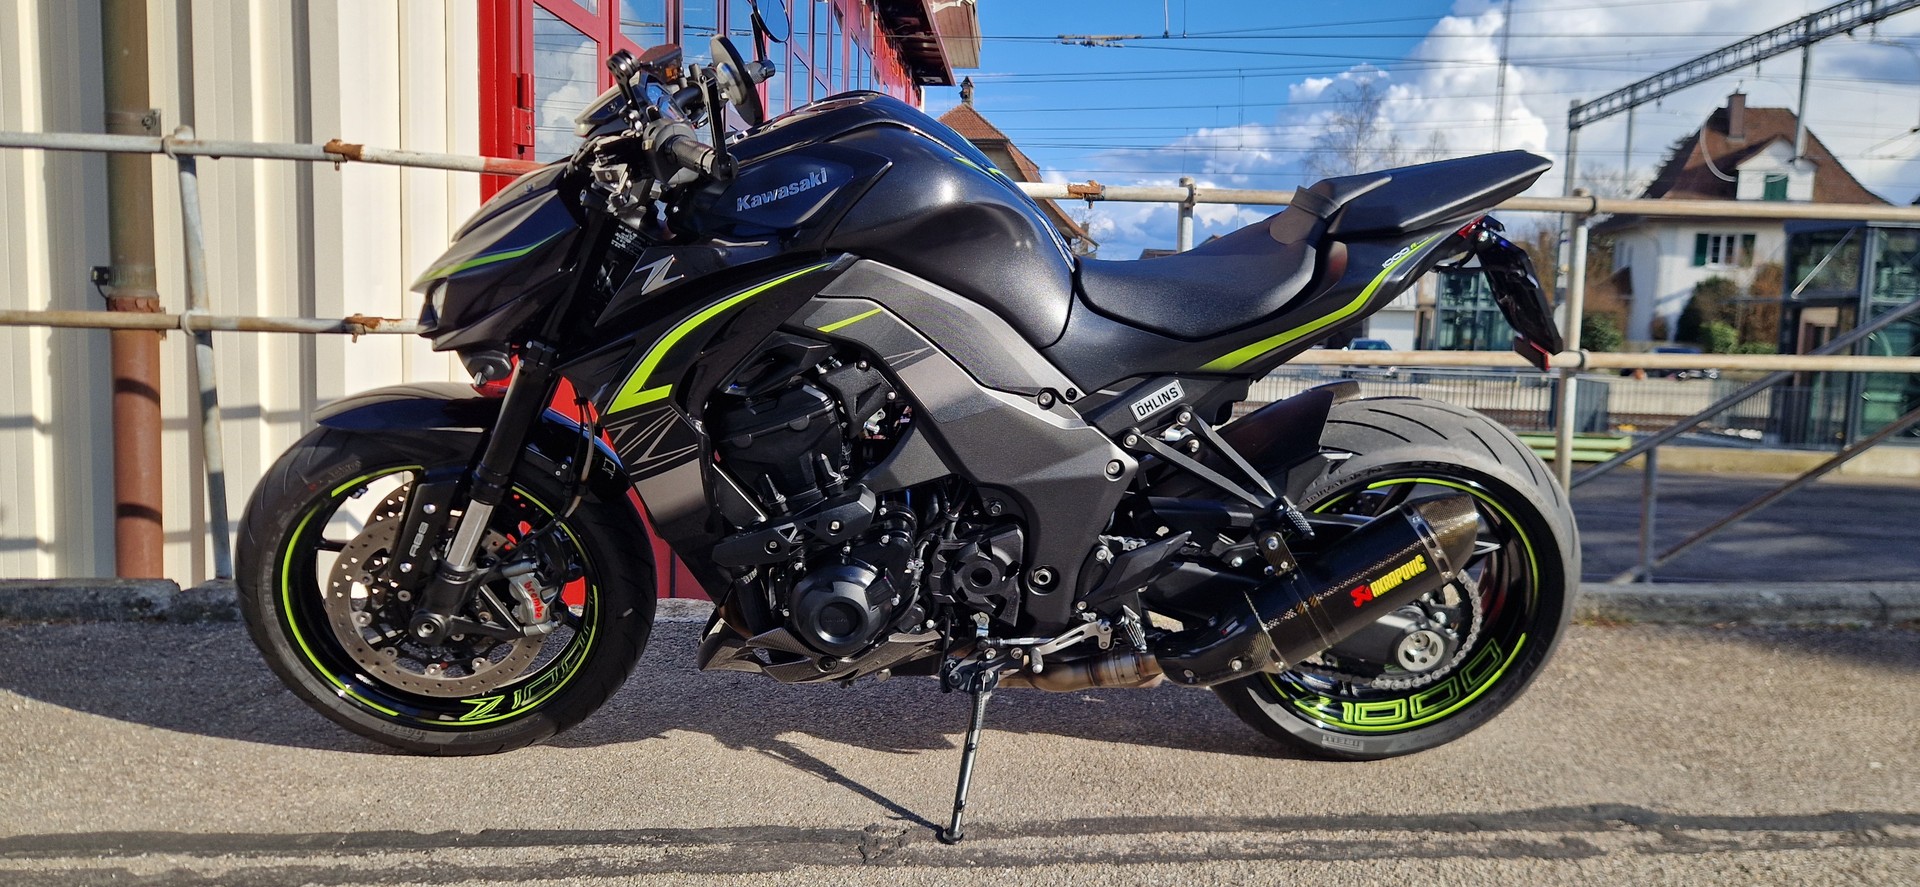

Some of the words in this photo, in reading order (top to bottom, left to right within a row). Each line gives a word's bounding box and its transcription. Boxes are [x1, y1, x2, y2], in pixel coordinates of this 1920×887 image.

[736, 167, 828, 212] Kawasaki
[1381, 246, 1410, 269] 1000
[1136, 386, 1179, 416] ÖHLINS
[523, 580, 545, 619] brembo
